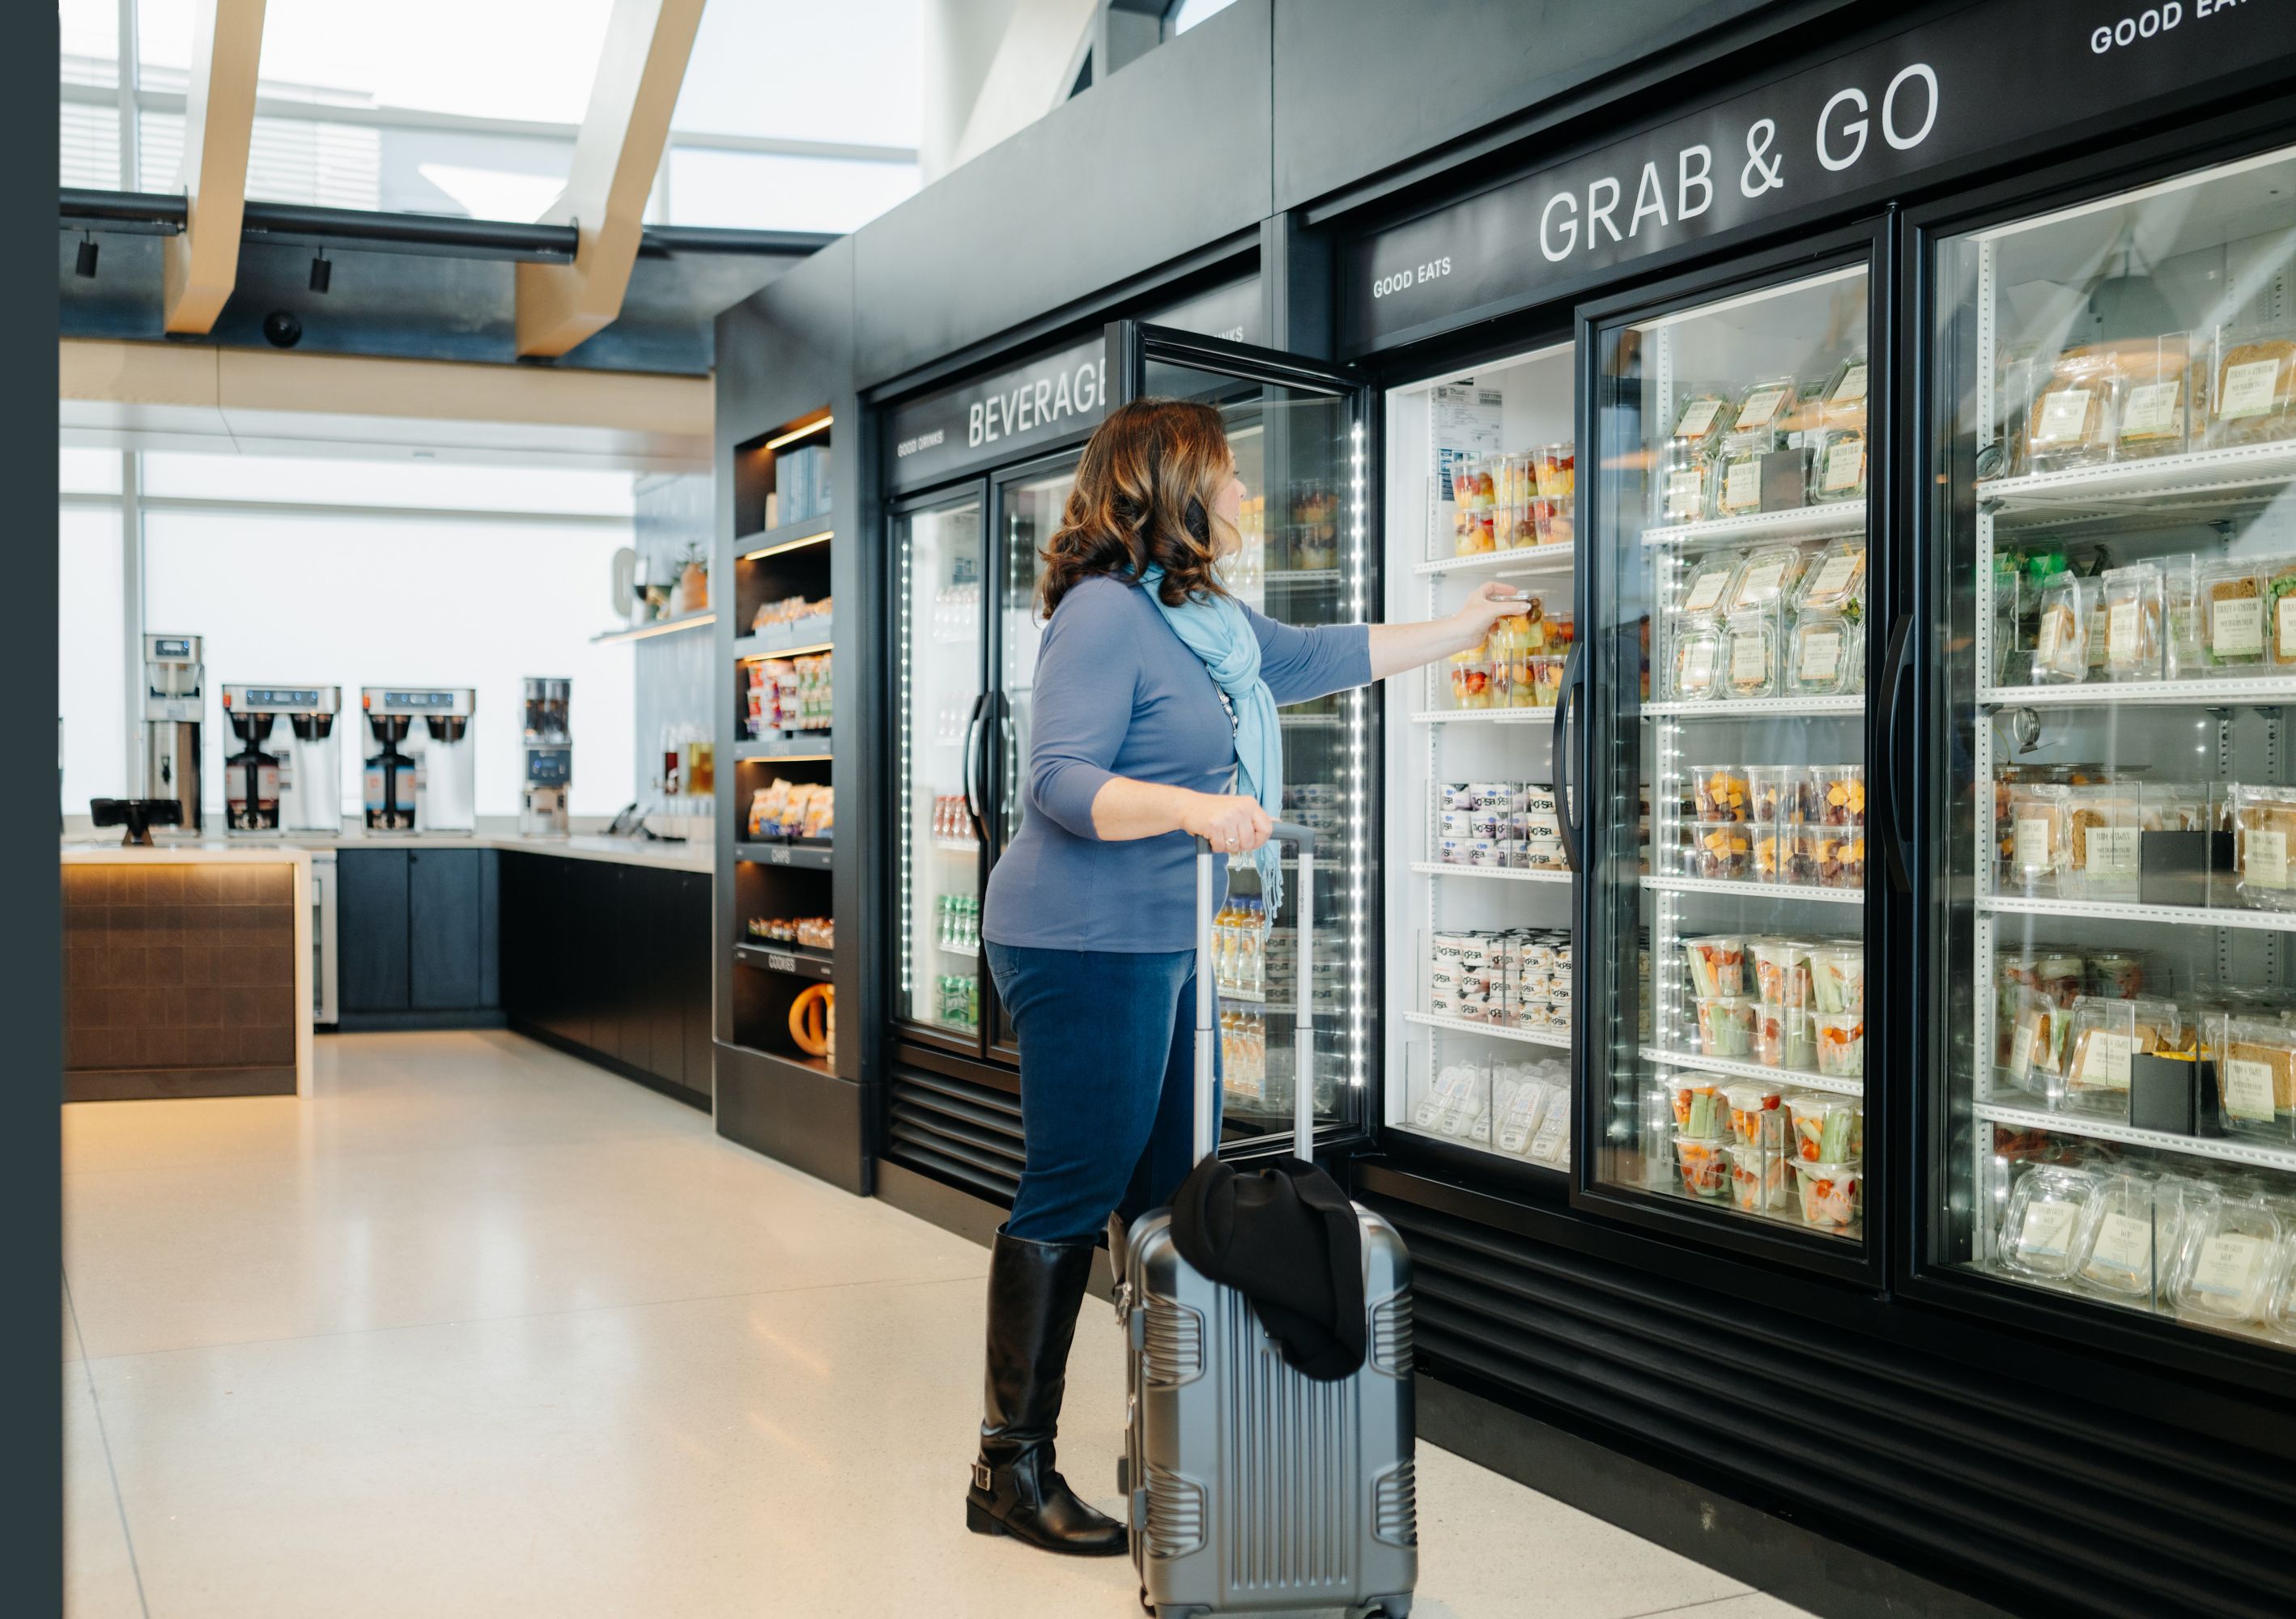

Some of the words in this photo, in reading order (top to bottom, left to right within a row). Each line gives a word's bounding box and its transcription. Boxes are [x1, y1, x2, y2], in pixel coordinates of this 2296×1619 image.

[2091, 2, 2183, 54] GOOD
[1540, 144, 1713, 262] GRAB
[1740, 118, 1784, 198] &
[1816, 63, 1939, 172] GO
[1373, 270, 1412, 299] GOOD
[1418, 257, 1451, 283] EATS
[969, 357, 1106, 448] BEVERAG
[897, 439, 916, 457] GOOD
[917, 429, 945, 450] DRINKS
[1464, 950, 1482, 959] oosa
[1435, 973, 1450, 983] oosa
[1463, 976, 1481, 985] oosa
[1461, 1004, 1478, 1013] oosa
